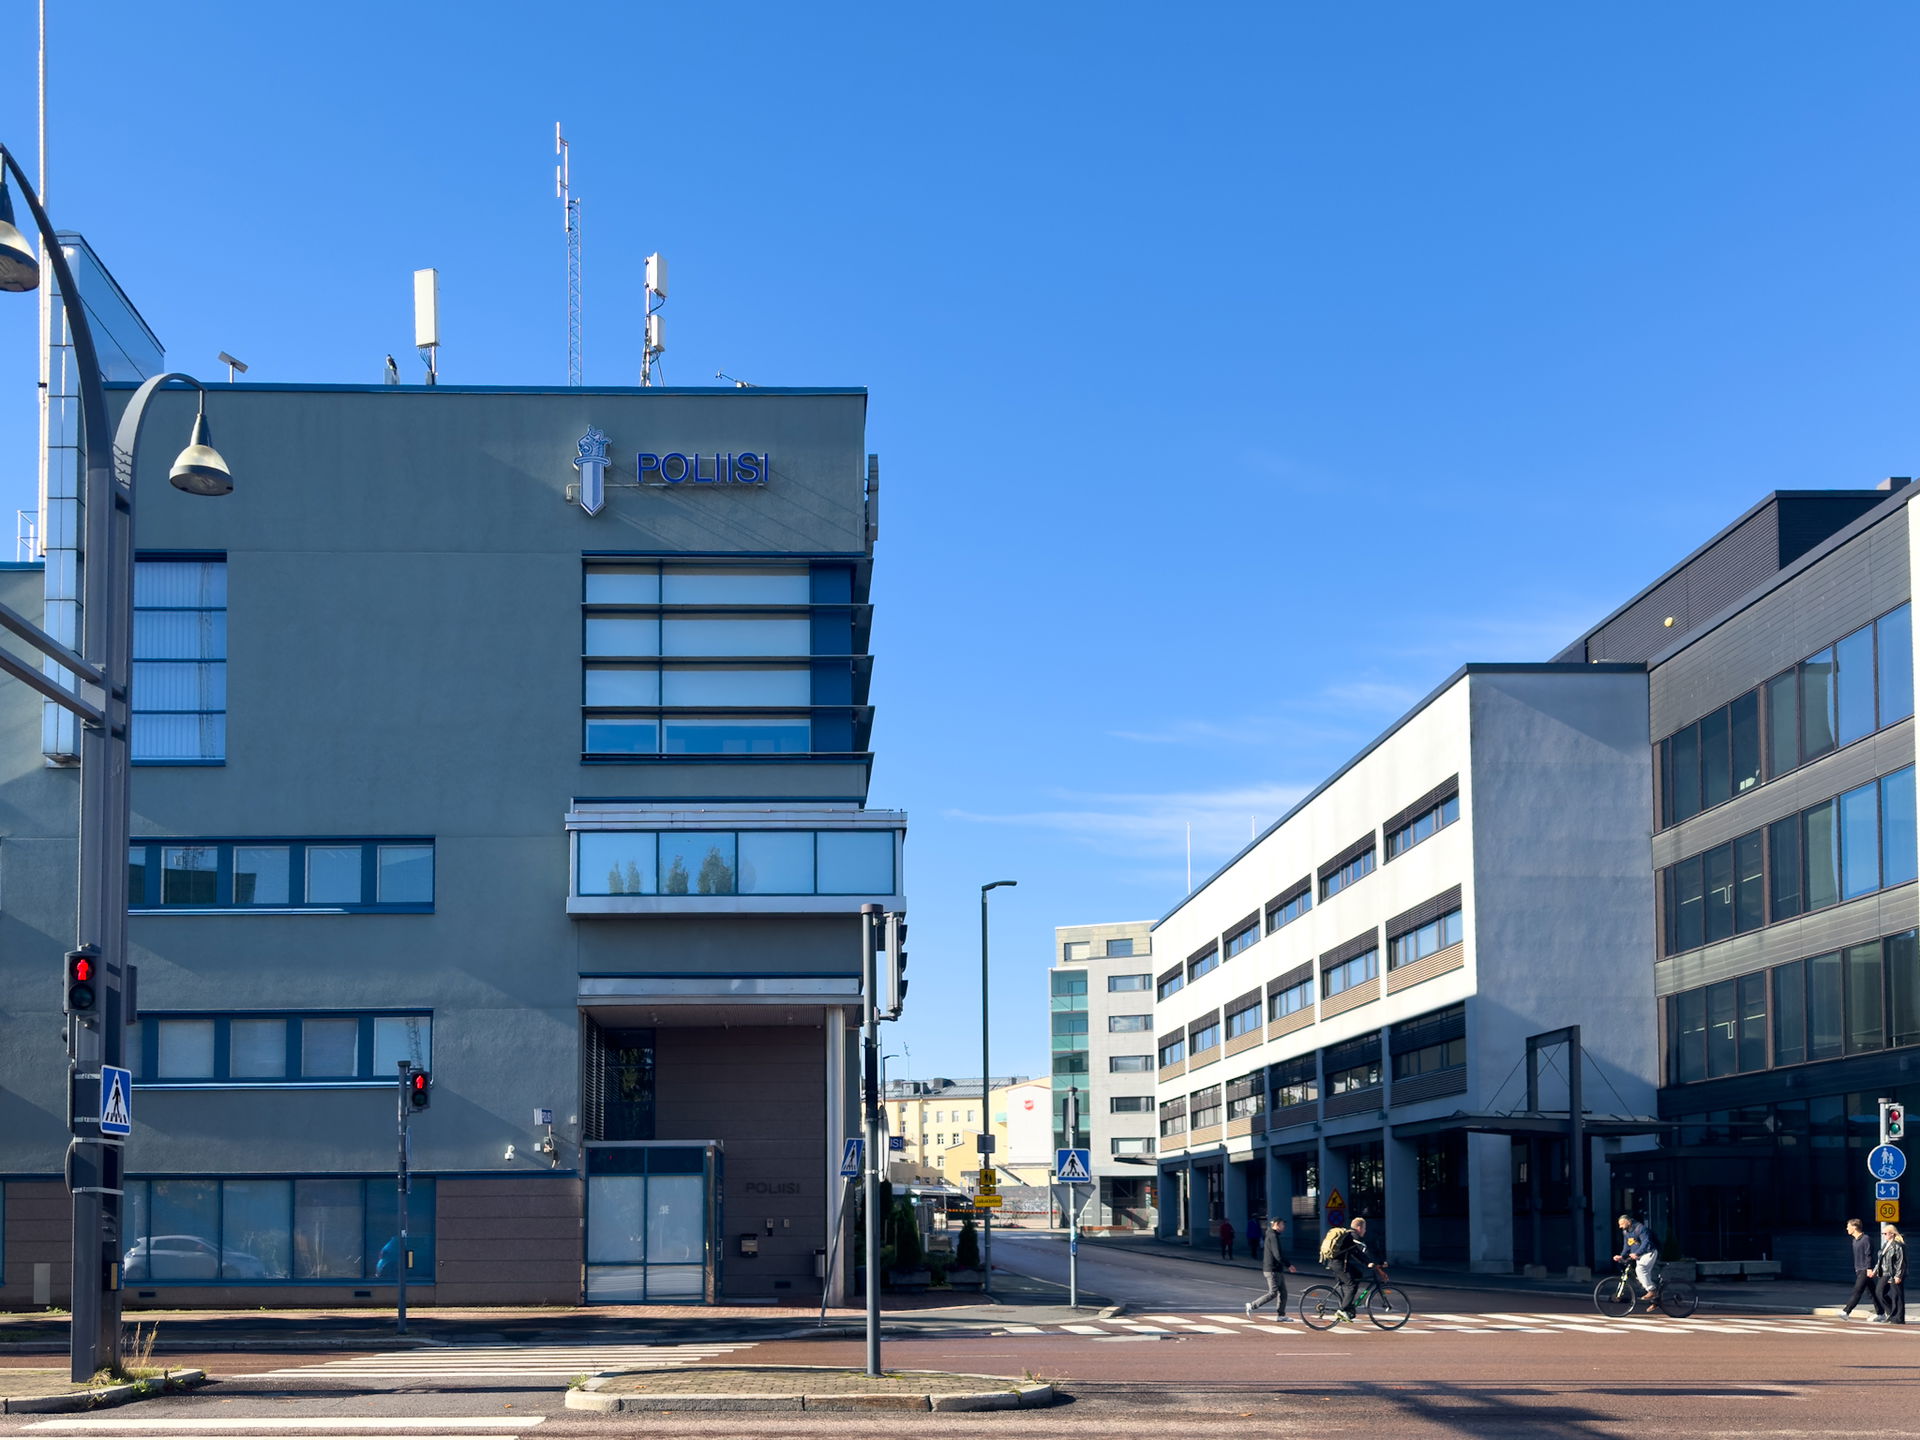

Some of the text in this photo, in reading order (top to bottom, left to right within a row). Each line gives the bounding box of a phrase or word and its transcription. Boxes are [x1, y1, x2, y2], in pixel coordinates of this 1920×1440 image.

[637, 452, 769, 483] POLIISI
[745, 1182, 801, 1194] POLIISI
[1882, 1206, 1893, 1215] 30
